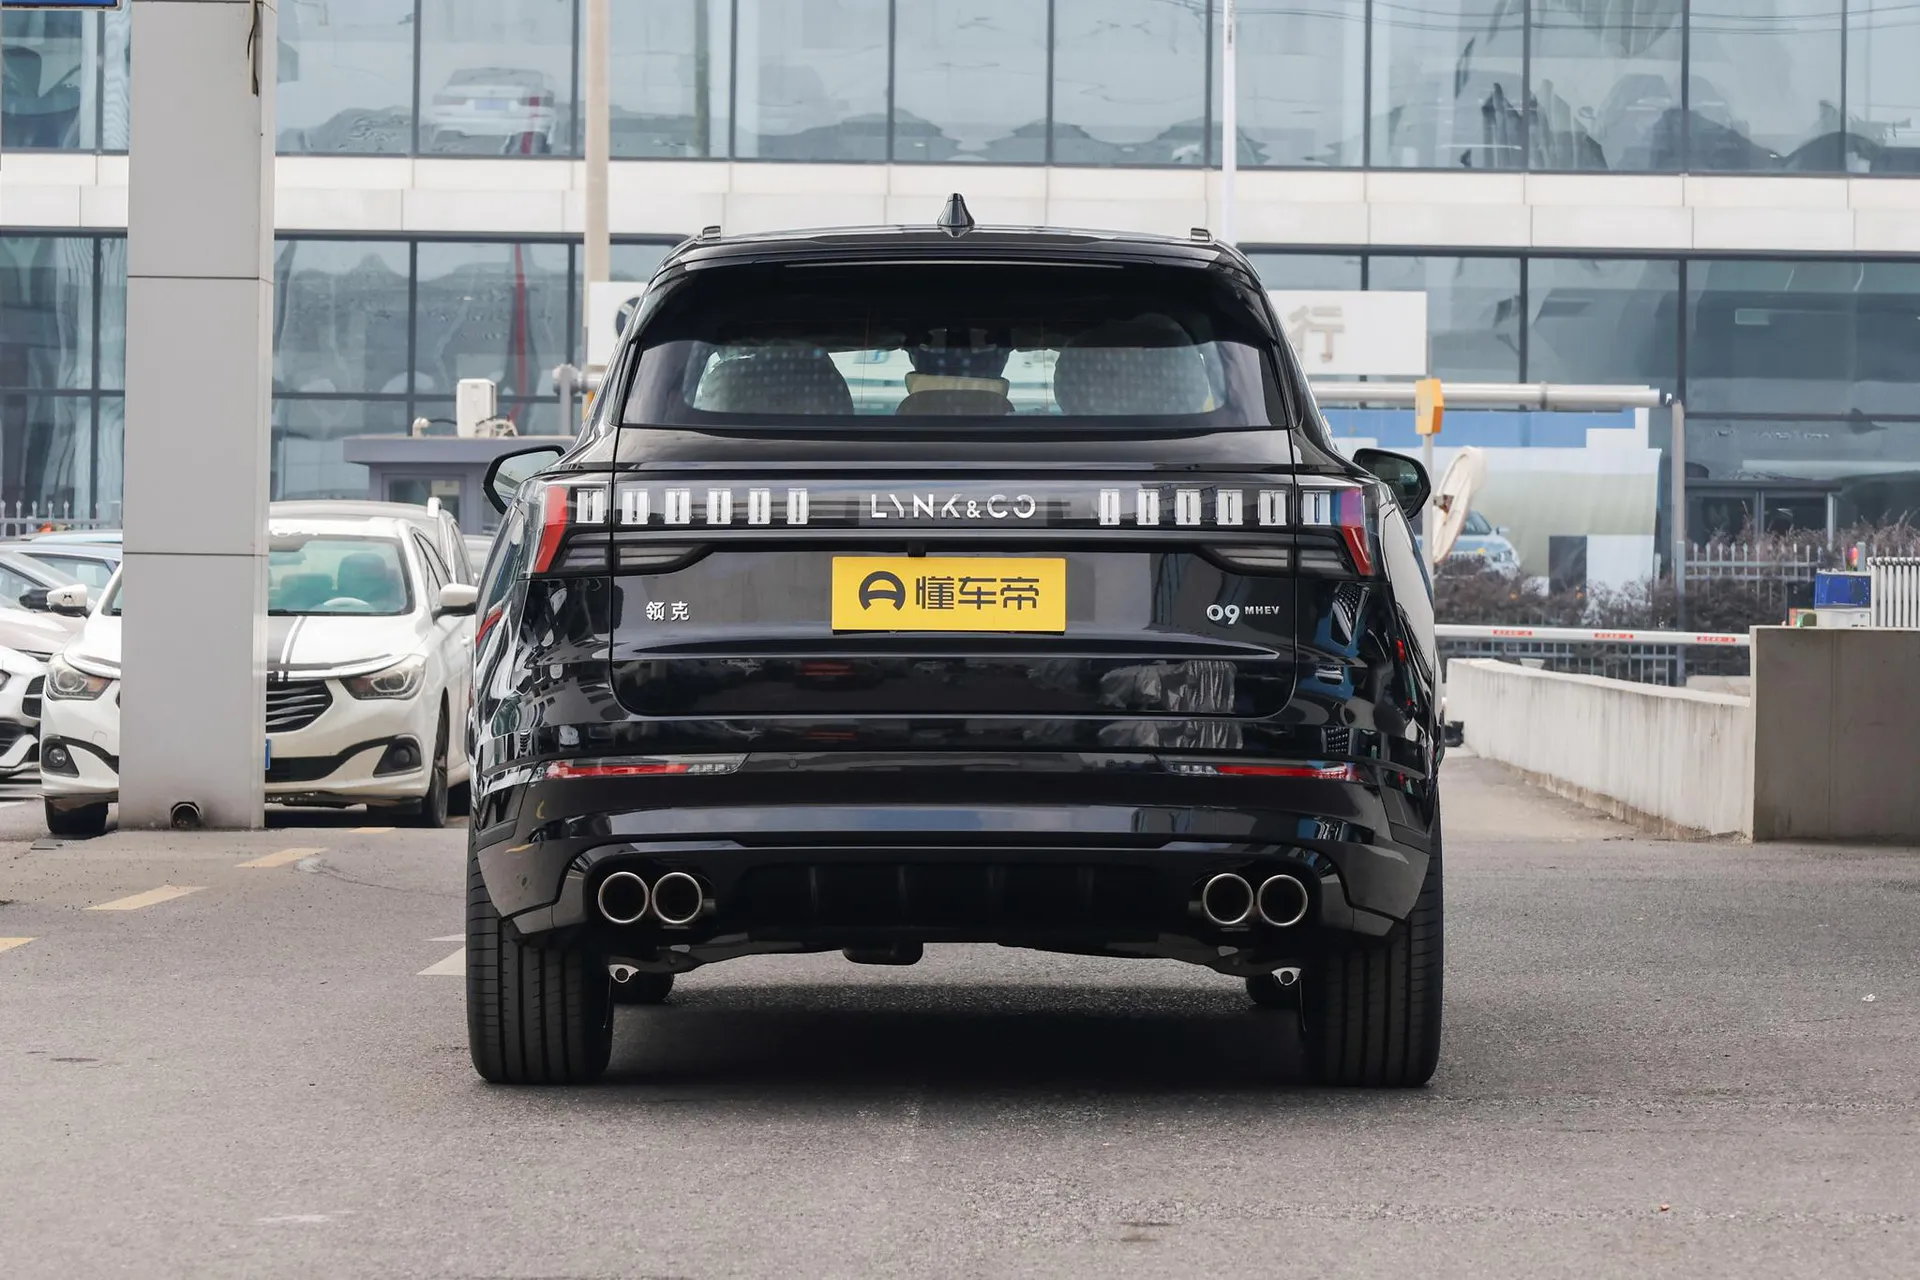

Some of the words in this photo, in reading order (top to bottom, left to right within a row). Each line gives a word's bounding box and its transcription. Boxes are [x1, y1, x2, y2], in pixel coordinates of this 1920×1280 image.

[871, 493, 1036, 519] LYNK&CO
[915, 576, 1040, 611] 懂车帝
[645, 600, 690, 621] 领克
[1206, 604, 1240, 625] 09
[1244, 606, 1280, 615] MHEV
